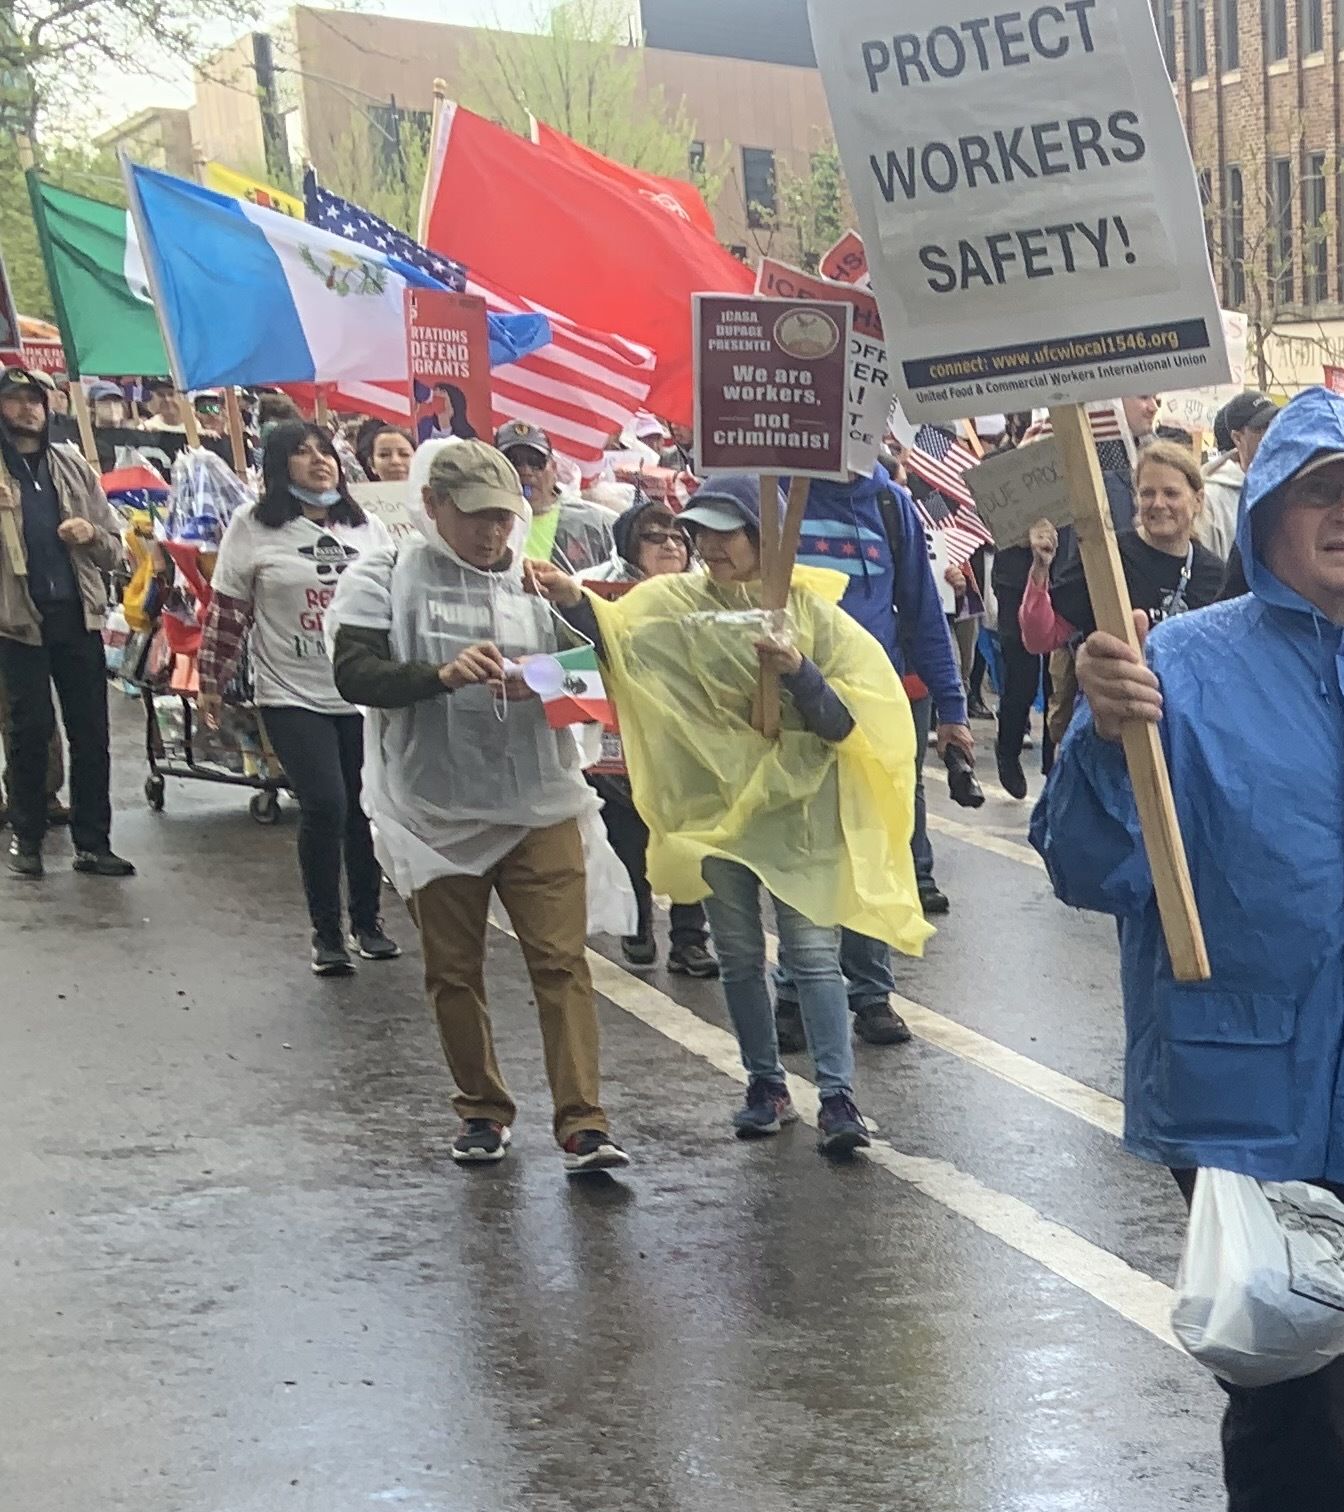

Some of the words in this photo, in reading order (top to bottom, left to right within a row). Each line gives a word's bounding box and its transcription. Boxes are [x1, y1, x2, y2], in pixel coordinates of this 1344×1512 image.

[861, 1, 1097, 93] PROTECT
[870, 110, 1146, 202] WORKERS
[918, 216, 1136, 293] SAFETY!
[411, 327, 468, 344] RTATIONS
[411, 342, 469, 361] DEFEND
[929, 355, 988, 378] connect:
[991, 329, 1179, 369] www.ufcwlocal1546.org
[412, 359, 470, 378] IGRANTS
[733, 365, 768, 383] We
[774, 368, 813, 385] are
[916, 388, 948, 403] United
[949, 383, 973, 398] Food
[985, 374, 1049, 394] Commercial
[1050, 368, 1096, 386] Workers
[1099, 358, 1172, 379] International
[1173, 352, 1207, 367] Union
[723, 385, 821, 407] workers,
[753, 413, 791, 429] not
[713, 427, 830, 450] criminals!
